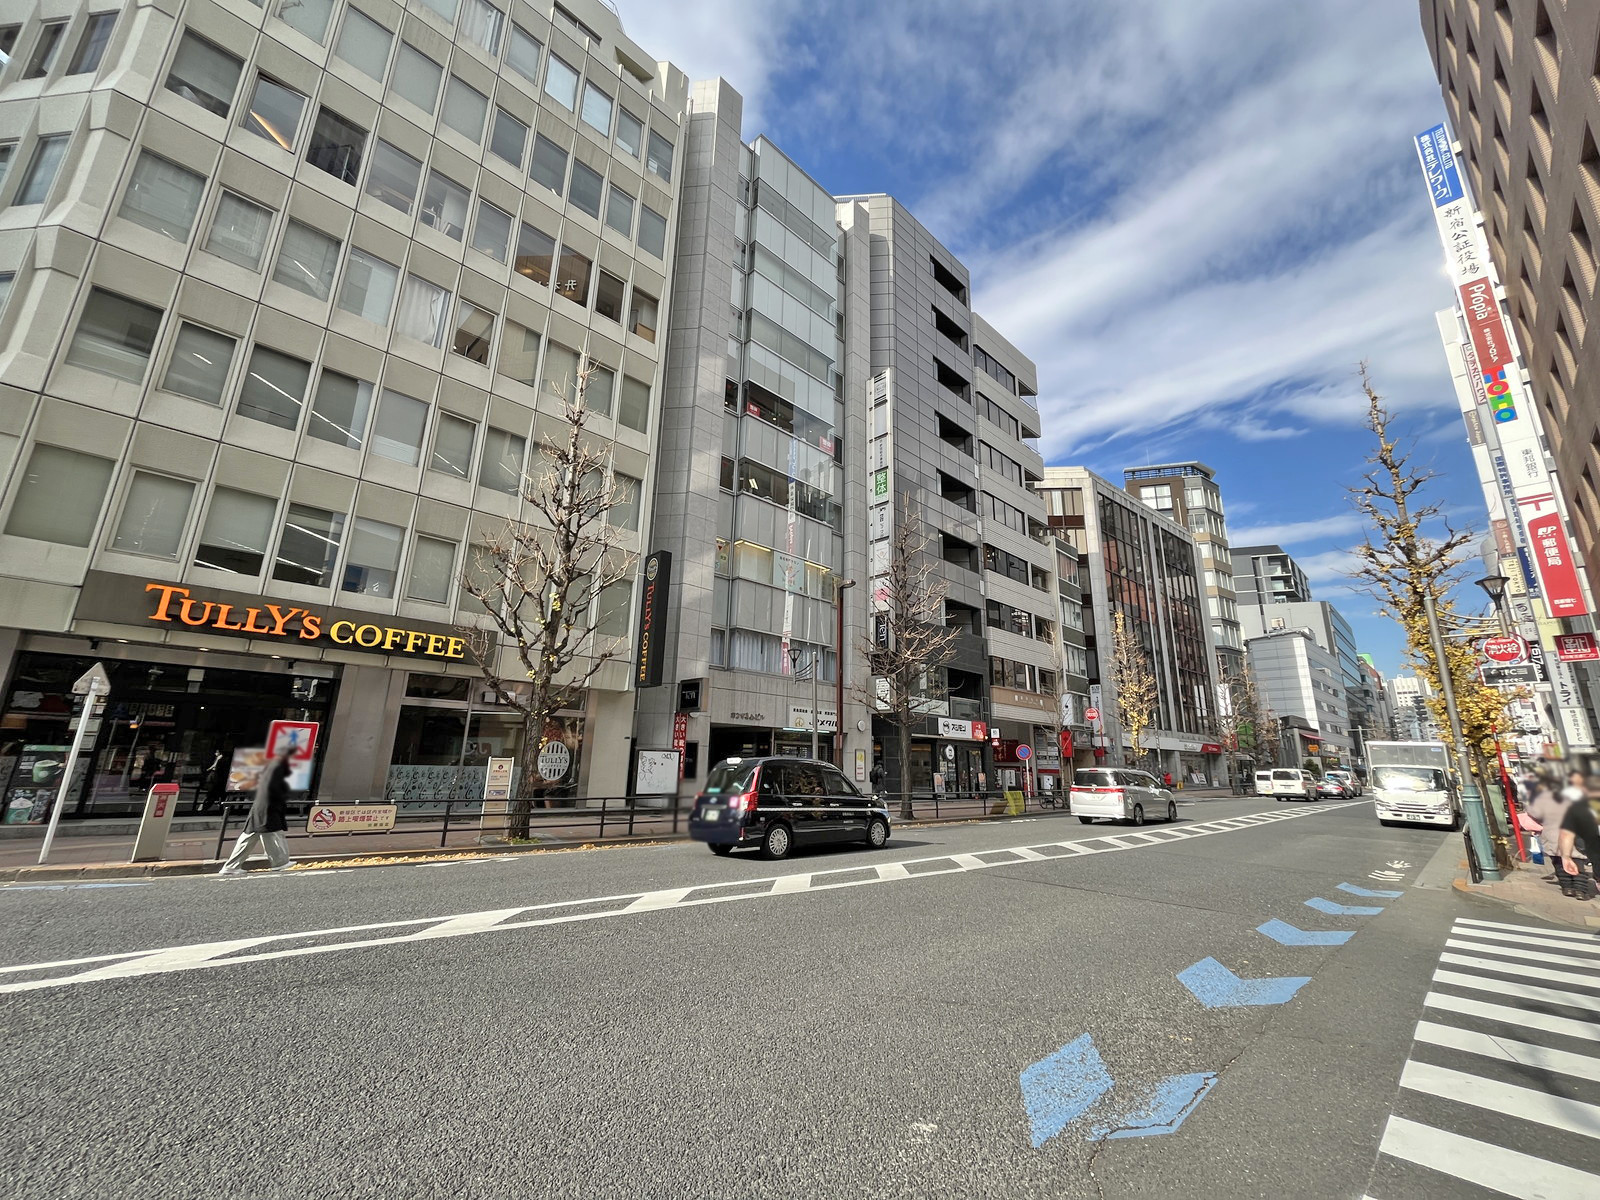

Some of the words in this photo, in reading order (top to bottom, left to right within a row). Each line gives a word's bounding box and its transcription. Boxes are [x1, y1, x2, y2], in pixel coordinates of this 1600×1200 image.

[1444, 205, 1480, 275] 新宿公証役場
[1468, 283, 1492, 321] Propia
[876, 472, 887, 495] 整体
[1541, 538, 1562, 567] 郵便局
[329, 620, 466, 659] COFFEE
[640, 632, 649, 682] COFFEE
[1486, 642, 1519, 655] 消火栓
